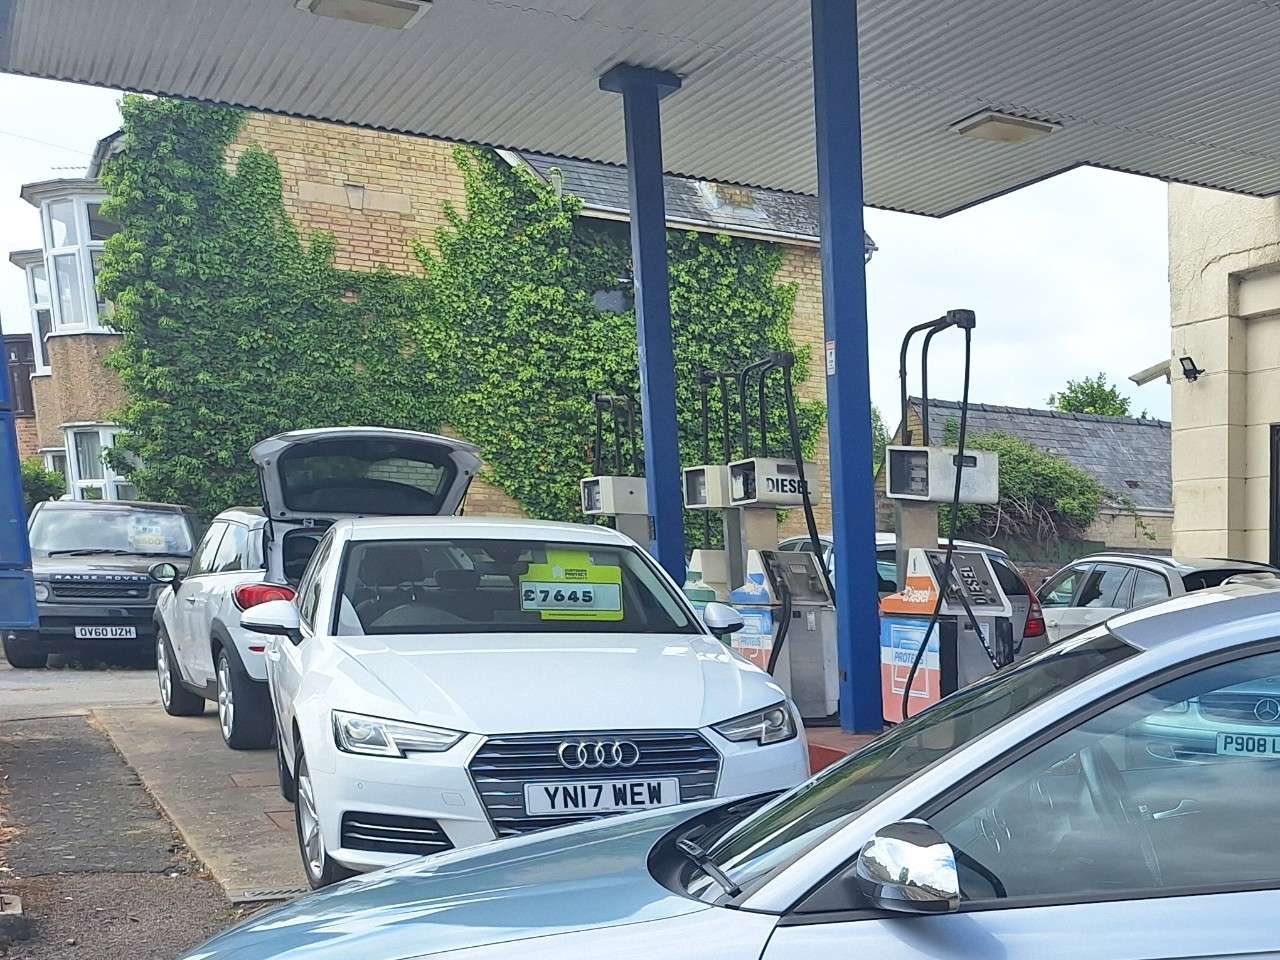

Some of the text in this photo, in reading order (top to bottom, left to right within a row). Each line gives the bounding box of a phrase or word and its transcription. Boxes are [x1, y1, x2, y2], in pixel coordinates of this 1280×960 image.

[523, 589, 593, 603] £7645
[80, 628, 132, 637] OV60 UZH
[895, 651, 924, 665] PROTES
[1223, 735, 1267, 753] P908
[544, 781, 662, 810] YN17 WEW
